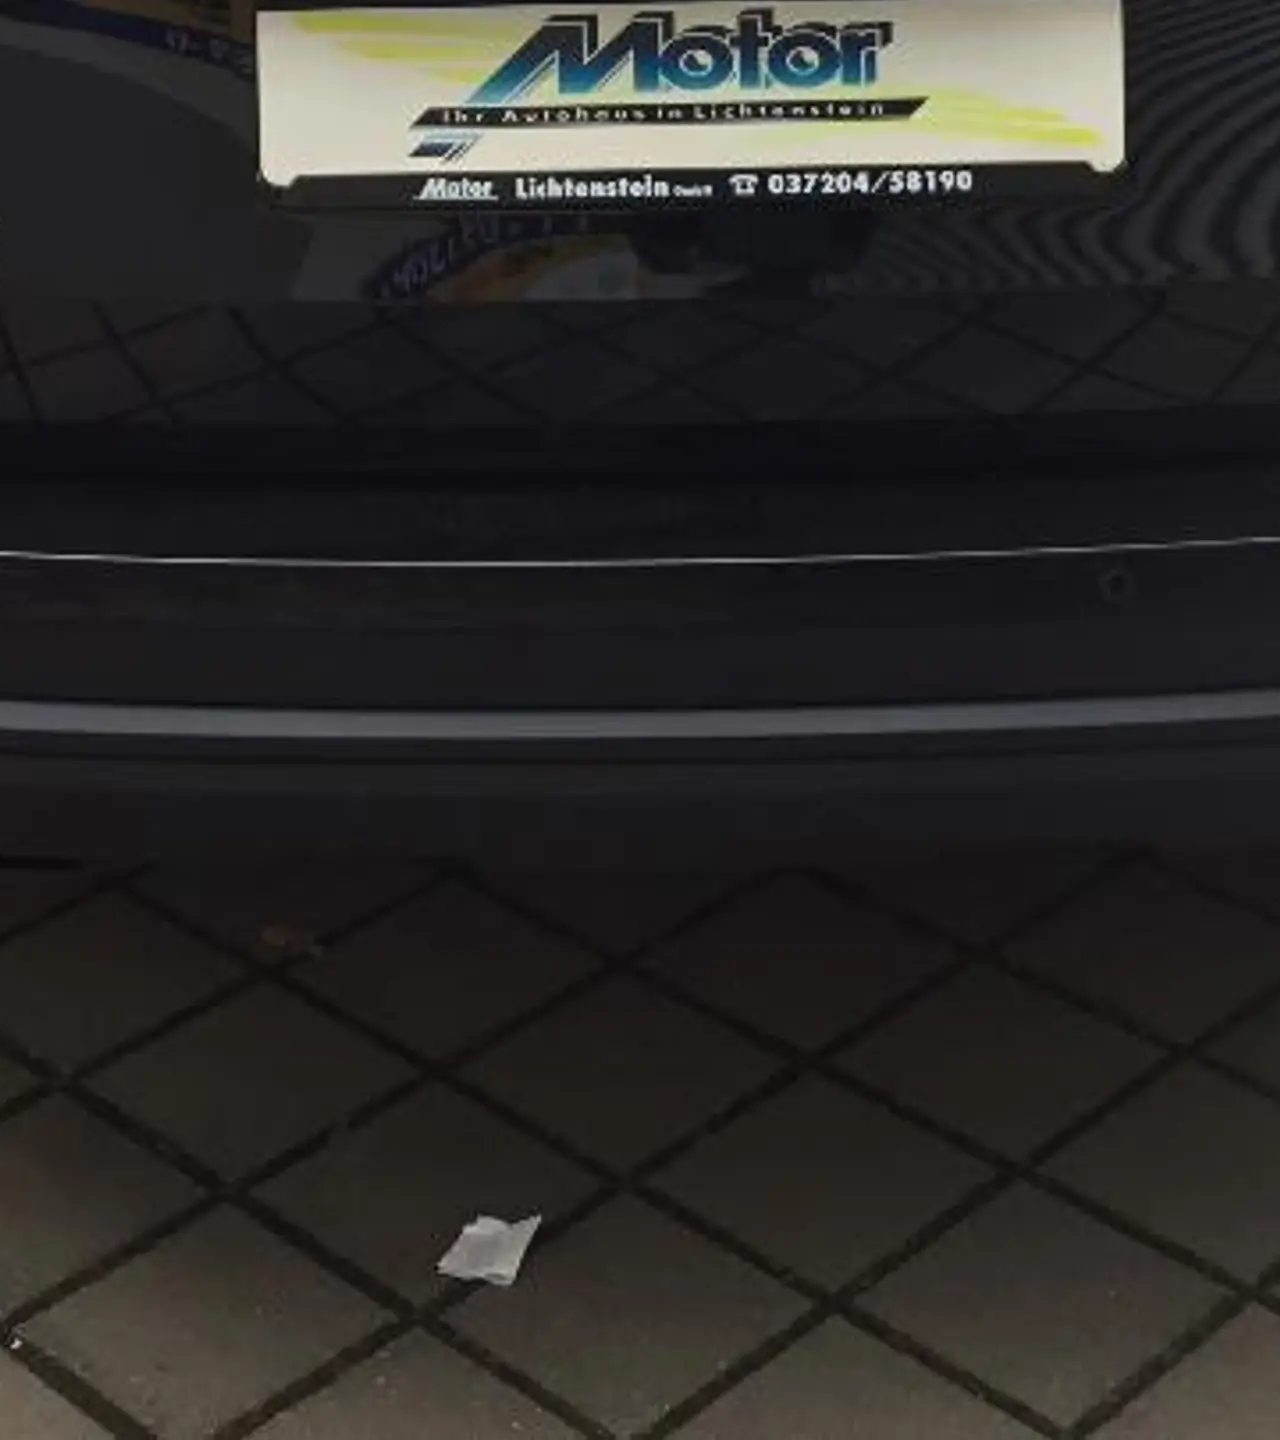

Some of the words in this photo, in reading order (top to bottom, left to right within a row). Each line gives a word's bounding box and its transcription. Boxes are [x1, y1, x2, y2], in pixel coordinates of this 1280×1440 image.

[465, 9, 893, 103] Motor
[443, 109, 485, 122] Ihr
[500, 106, 646, 122] Autohaus
[656, 105, 683, 119] in
[692, 104, 884, 120] Lichtenstein
[420, 177, 498, 200] Motor
[516, 175, 671, 198] Lichtenstein
[767, 170, 973, 194] 037204/58190
